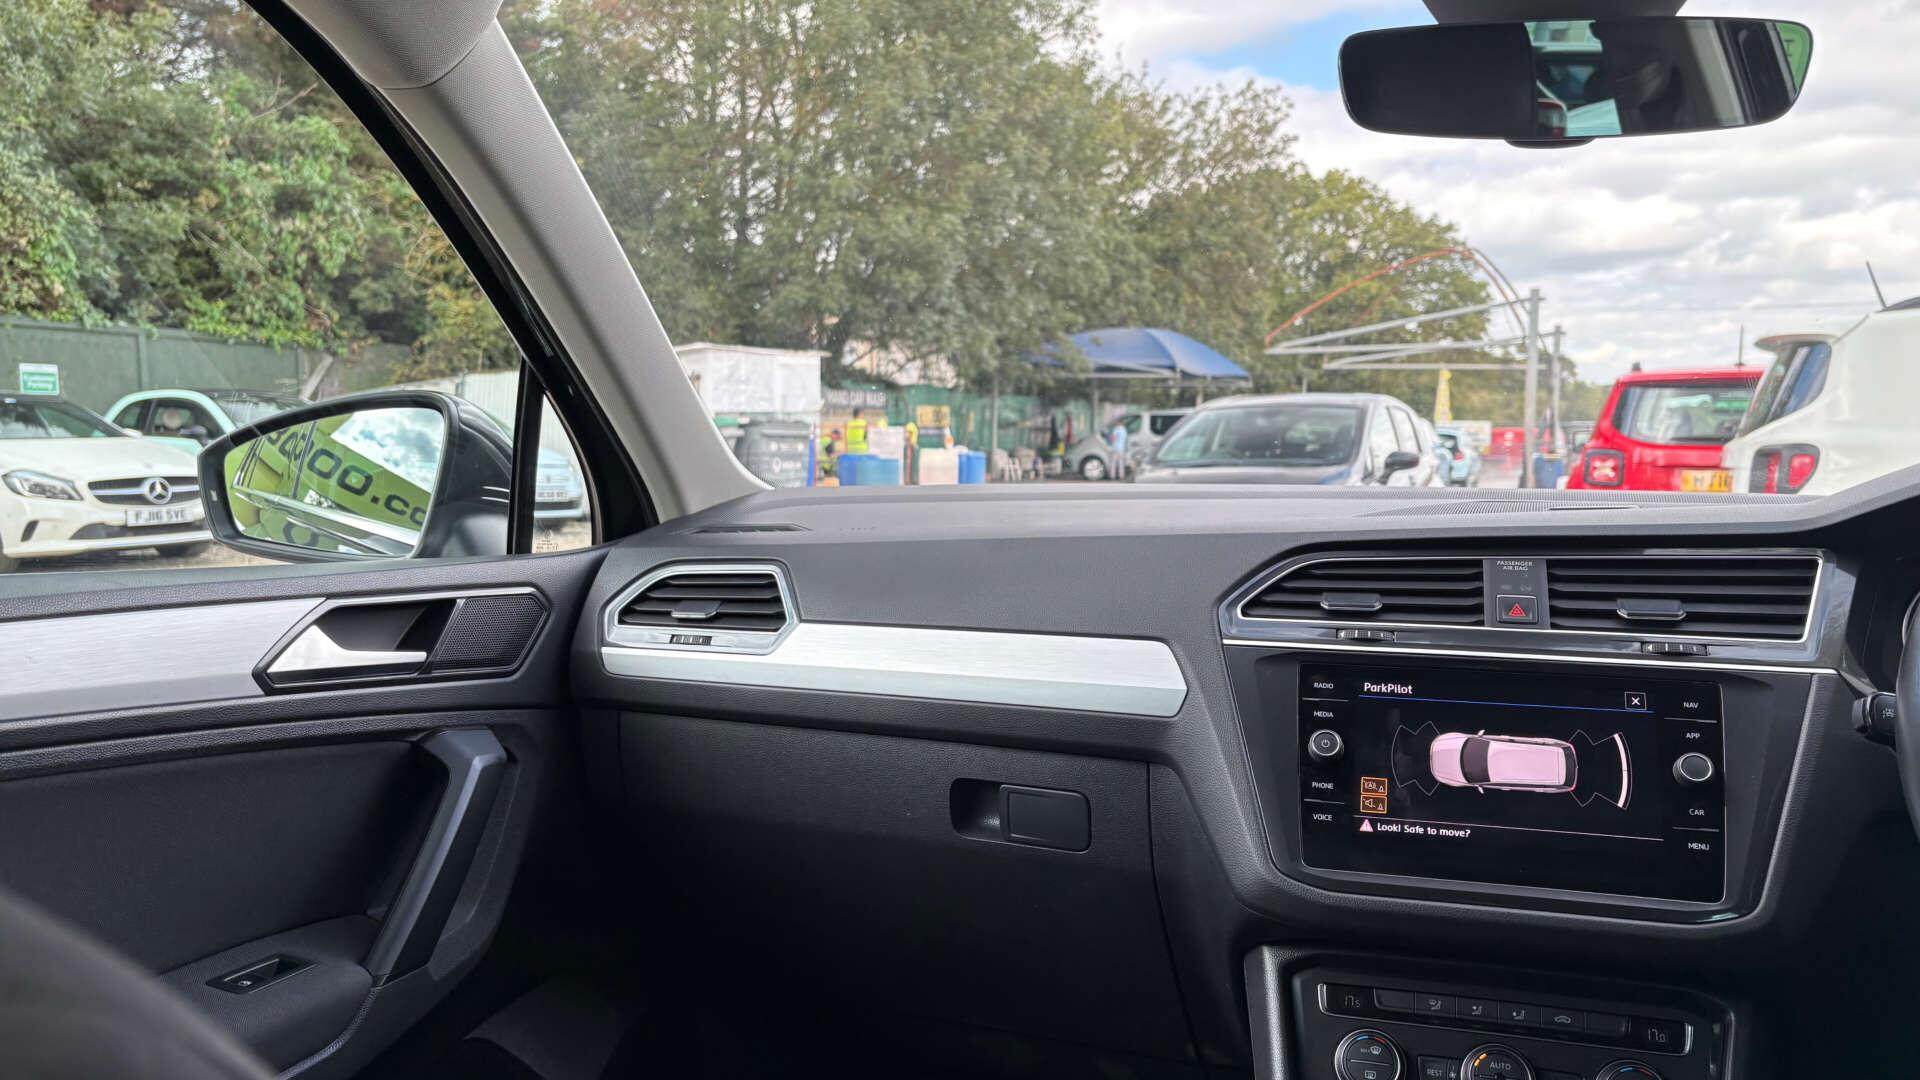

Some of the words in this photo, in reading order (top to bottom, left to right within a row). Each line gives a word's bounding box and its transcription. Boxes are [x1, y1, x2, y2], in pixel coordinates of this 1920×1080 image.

[1313, 682, 1334, 690] RADIO
[1363, 682, 1413, 695] ParkPilot
[1683, 701, 1699, 709] NAV
[1313, 710, 1334, 718] MEDIA
[1311, 781, 1334, 790] PHONE
[1688, 808, 1705, 816] CAR
[1312, 813, 1333, 822] VOICE
[1377, 822, 1401, 832] Look!
[1404, 825, 1424, 835] Safe
[1427, 827, 1437, 836] to
[1439, 829, 1471, 838] move?
[1688, 842, 1710, 851] MENU
[1489, 1060, 1512, 1071] AUTO
